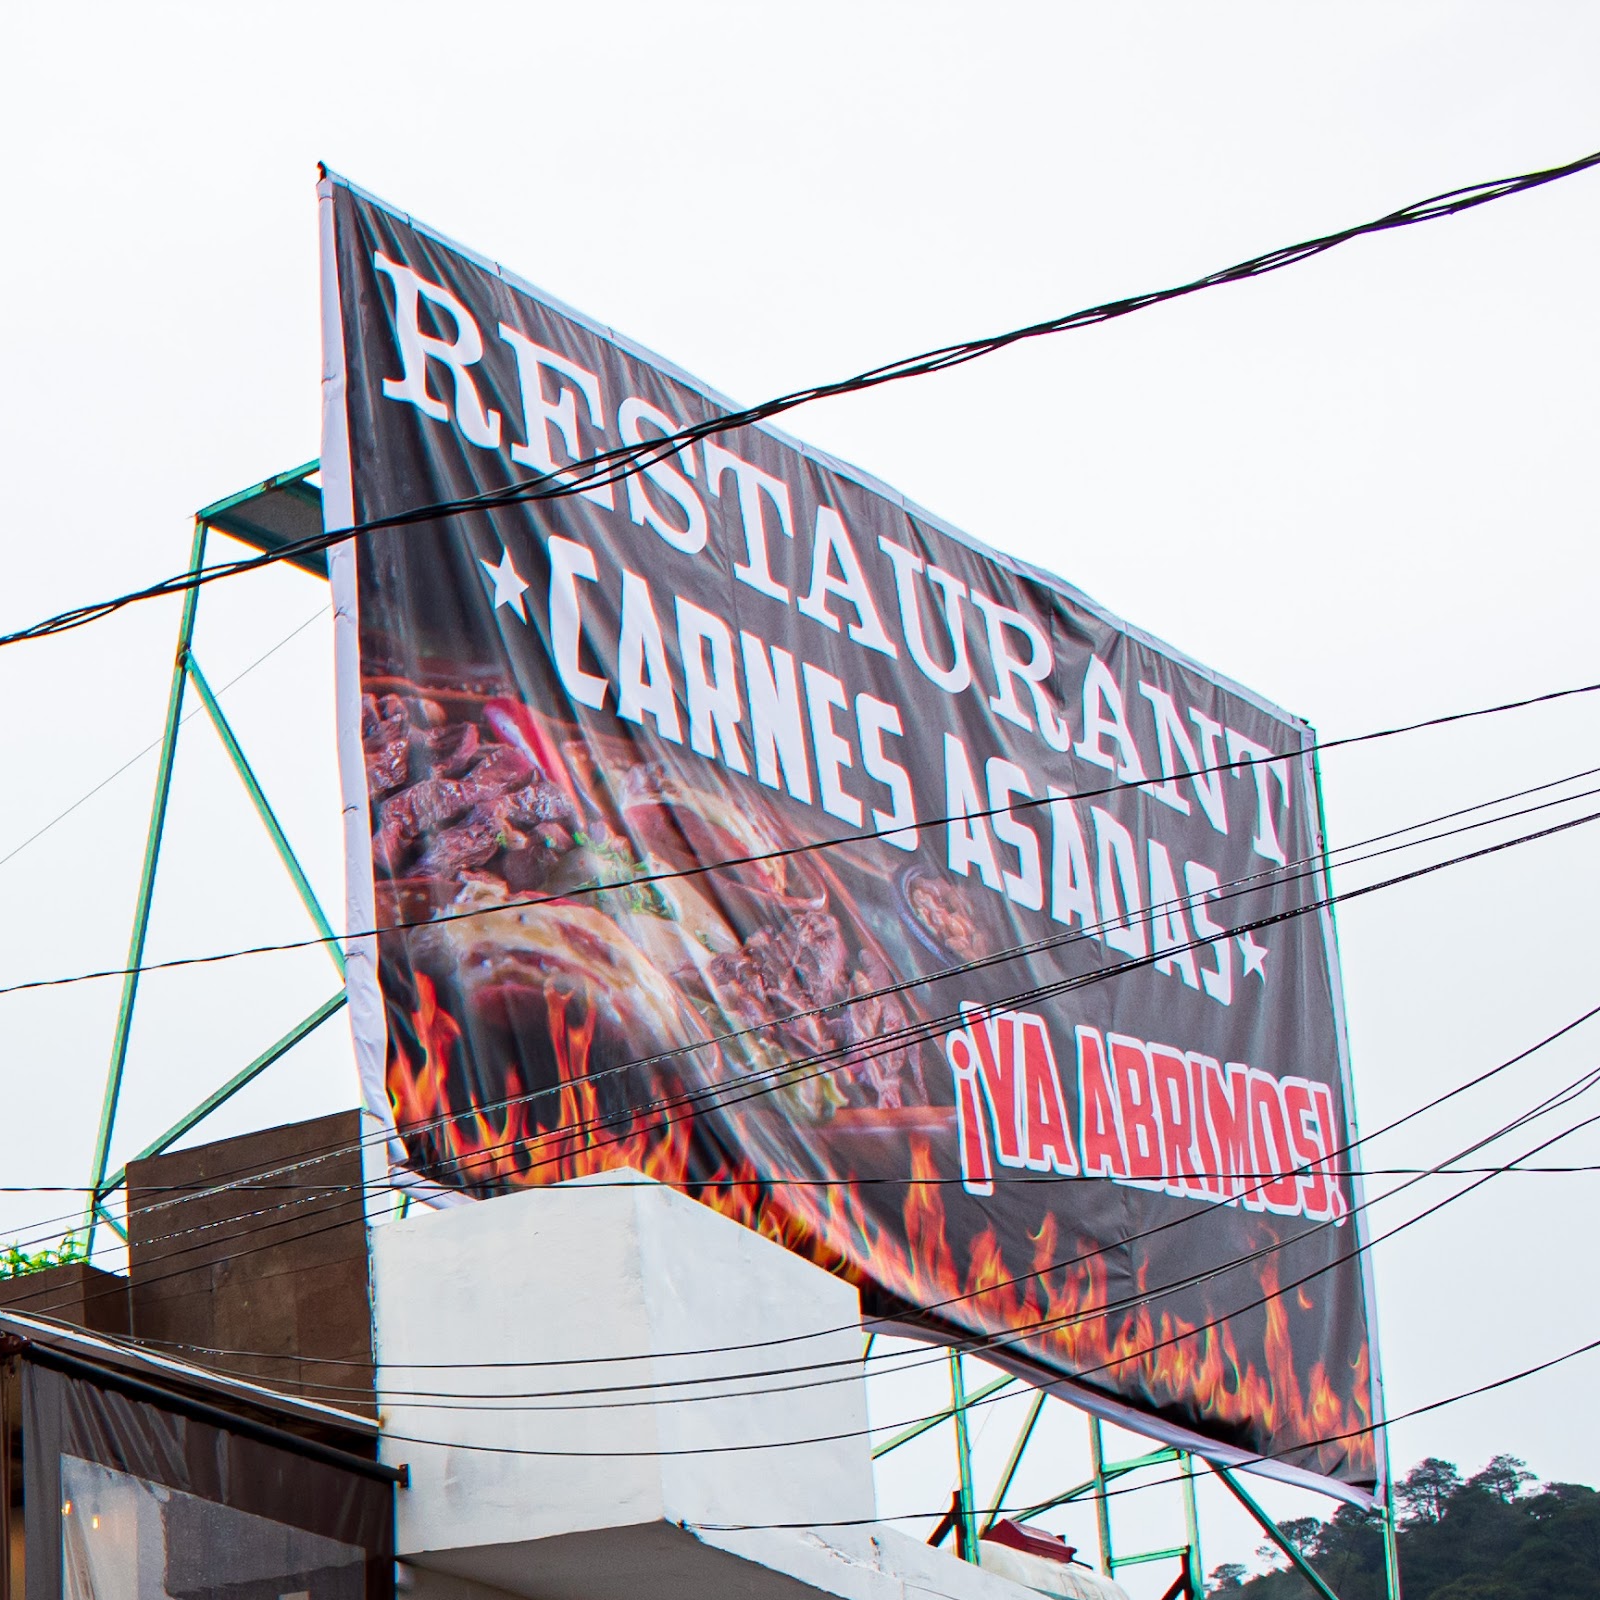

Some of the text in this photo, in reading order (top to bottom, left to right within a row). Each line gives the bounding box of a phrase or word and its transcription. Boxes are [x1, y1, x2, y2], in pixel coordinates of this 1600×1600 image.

[373, 249, 1290, 865] RESTAURANT
[546, 533, 1233, 1008] CARNES ASADAS
[945, 999, 1347, 1228] ¡YA ABRIMOS!
